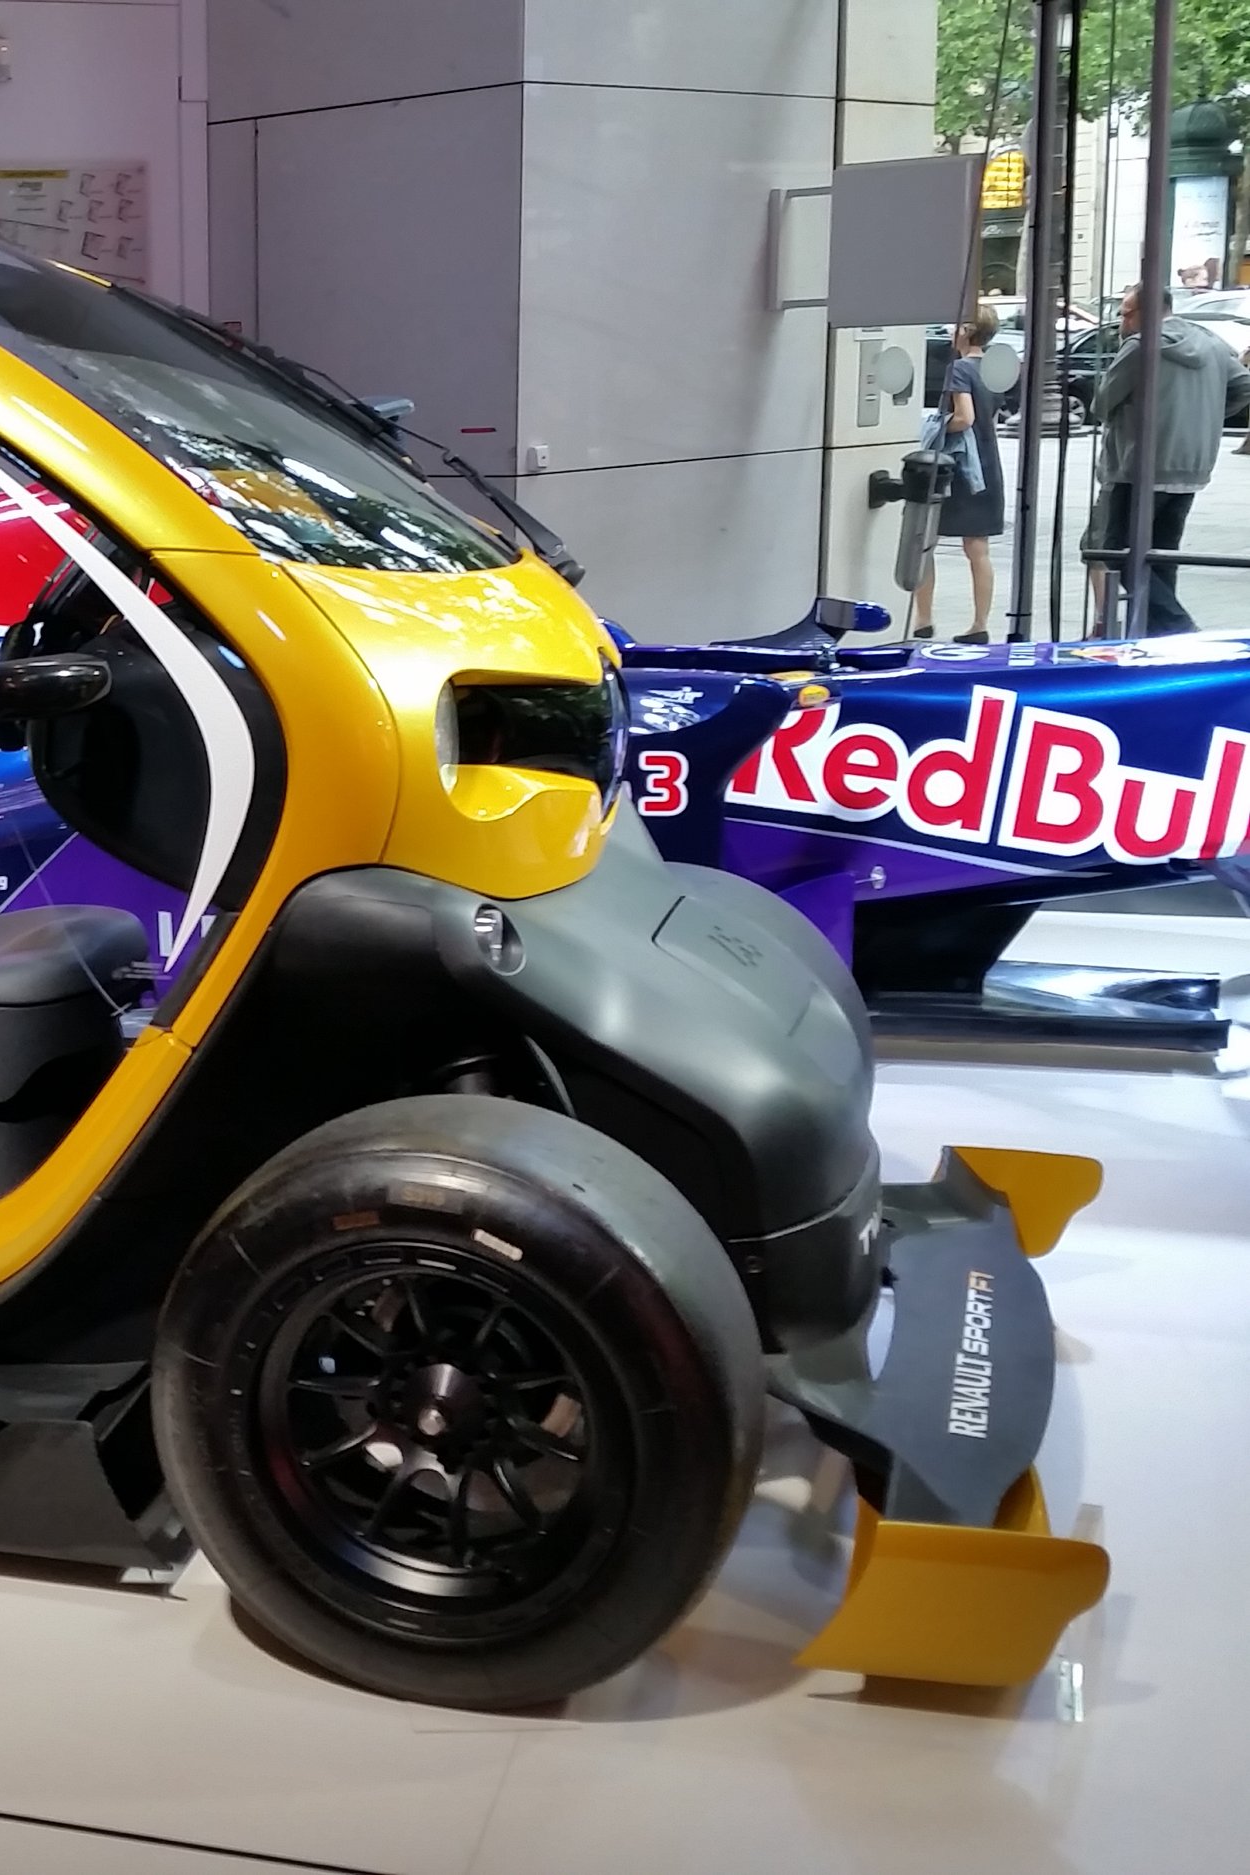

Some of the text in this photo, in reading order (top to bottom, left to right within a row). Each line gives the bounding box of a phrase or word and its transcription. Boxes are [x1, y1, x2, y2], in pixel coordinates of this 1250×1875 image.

[639, 751, 688, 816] 3
[999, 707, 1250, 864] Bul
[948, 1353, 992, 1439] RENAULT
